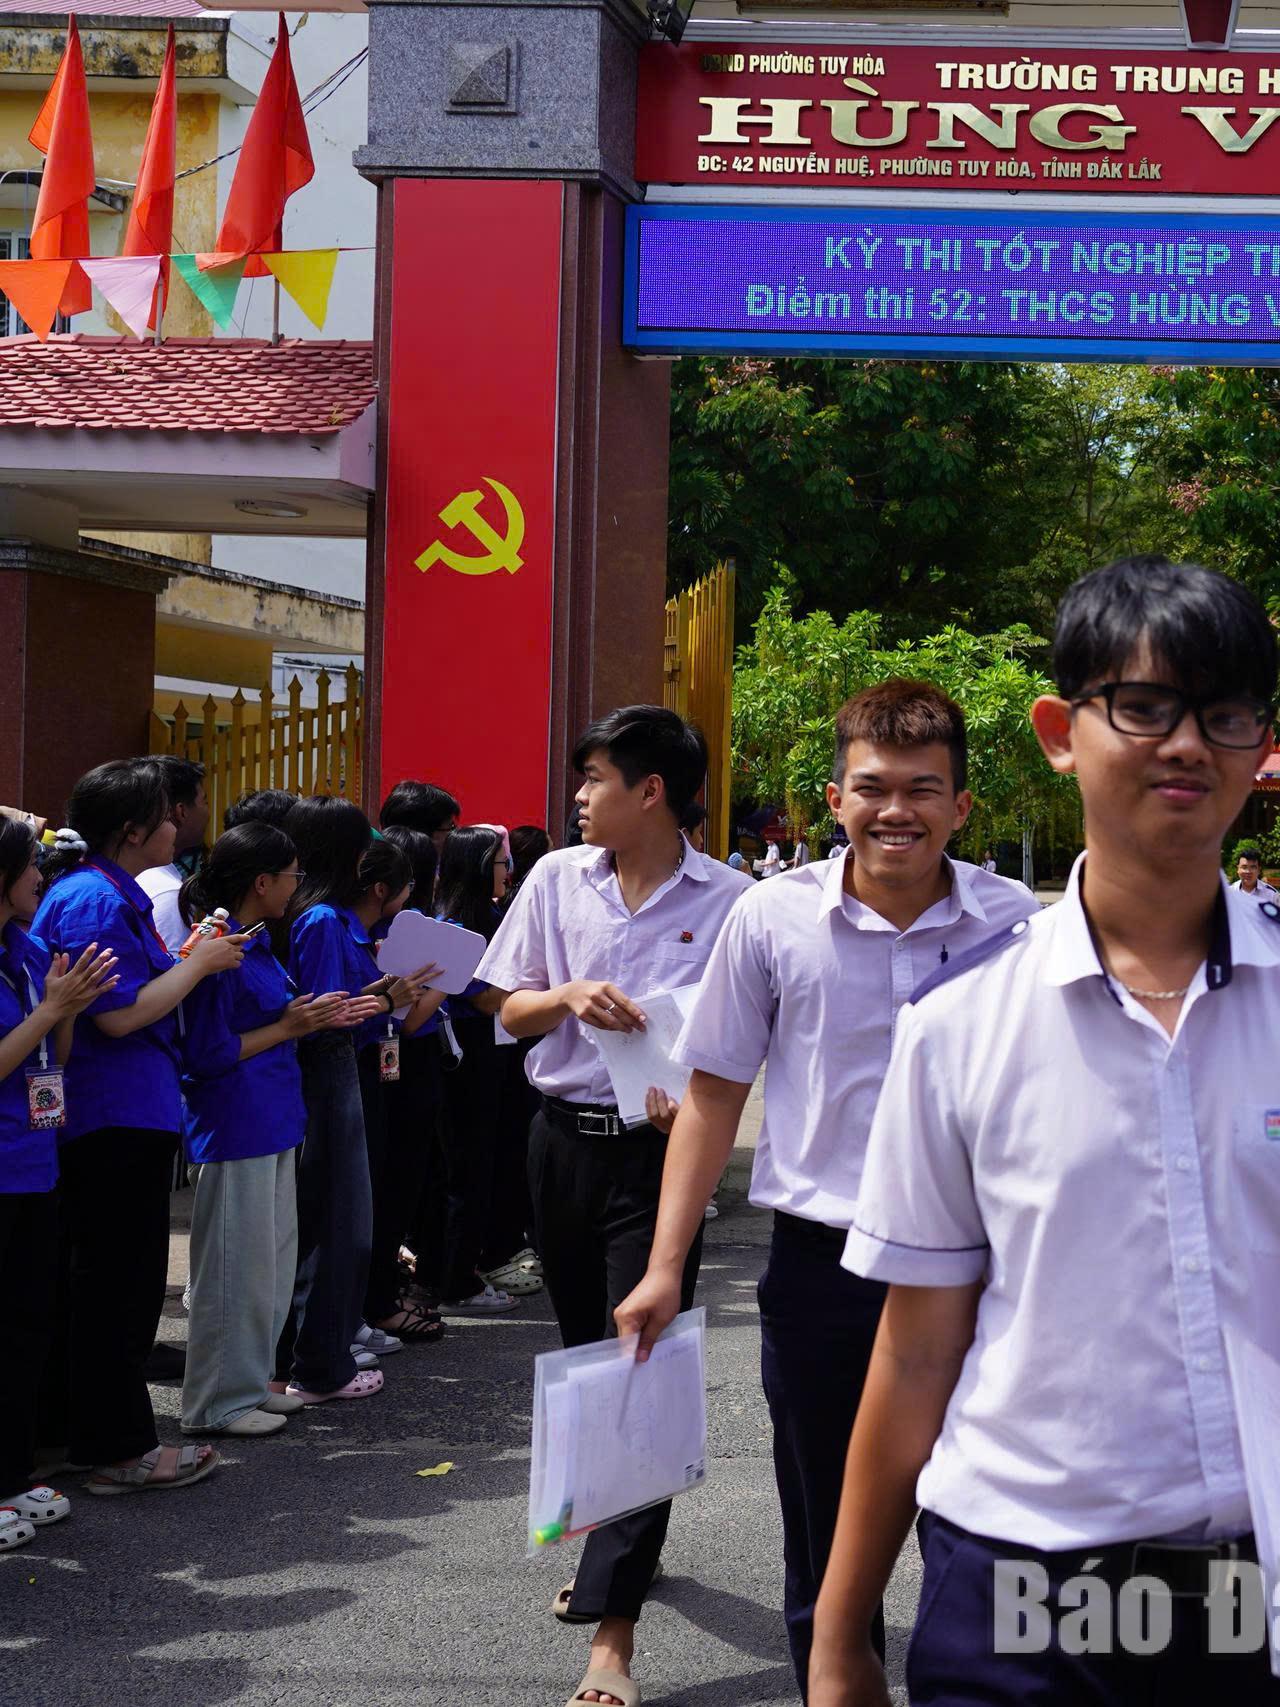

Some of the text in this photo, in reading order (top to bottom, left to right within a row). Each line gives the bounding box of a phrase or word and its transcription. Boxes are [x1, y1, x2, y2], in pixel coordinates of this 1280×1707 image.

[748, 51, 815, 75] PHƯỜNG
[820, 56, 850, 75] TUY
[853, 53, 885, 76] HÒA
[935, 57, 1097, 92] TRƯỜNG
[1110, 64, 1244, 95] TRUNG
[698, 78, 1136, 151] HÙNG
[697, 152, 1162, 181] ĐC: 42 NGUYỄN HUỆ, PHƯỜNG TUY HÒA, TỈNH ĐẮK LẮK
[824, 227, 886, 271] KỲ
[895, 238, 963, 272] THI
[1071, 235, 1231, 288] NGHIỆP
[744, 275, 852, 318] Điểm
[864, 286, 915, 319] thi
[927, 288, 988, 321] 52:
[1001, 289, 1115, 324] THCS
[1126, 282, 1253, 327] HÙNG
